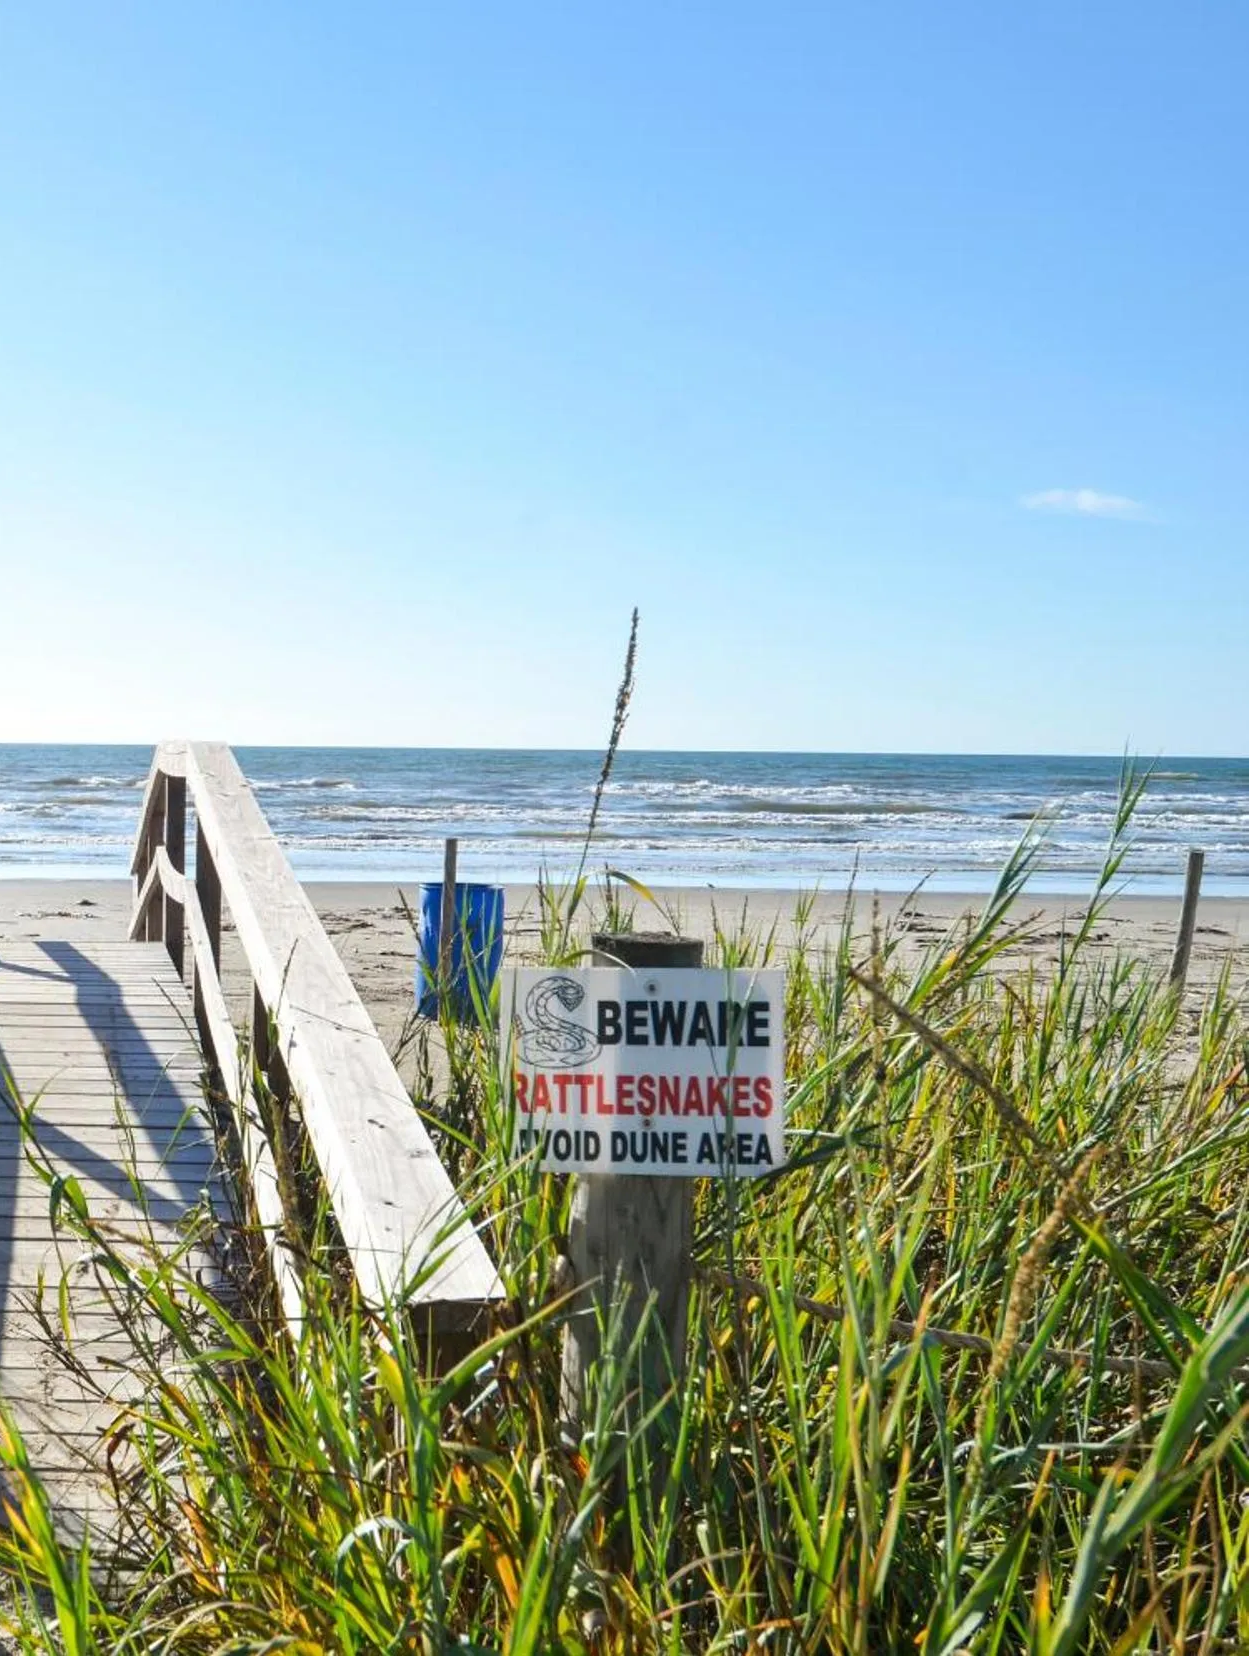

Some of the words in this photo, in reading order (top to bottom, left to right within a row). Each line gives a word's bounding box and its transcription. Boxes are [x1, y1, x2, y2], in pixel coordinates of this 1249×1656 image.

[597, 1000, 770, 1047] BEWARE
[514, 1073, 773, 1118] RATTLESNAKES
[610, 1131, 687, 1164] DUNE
